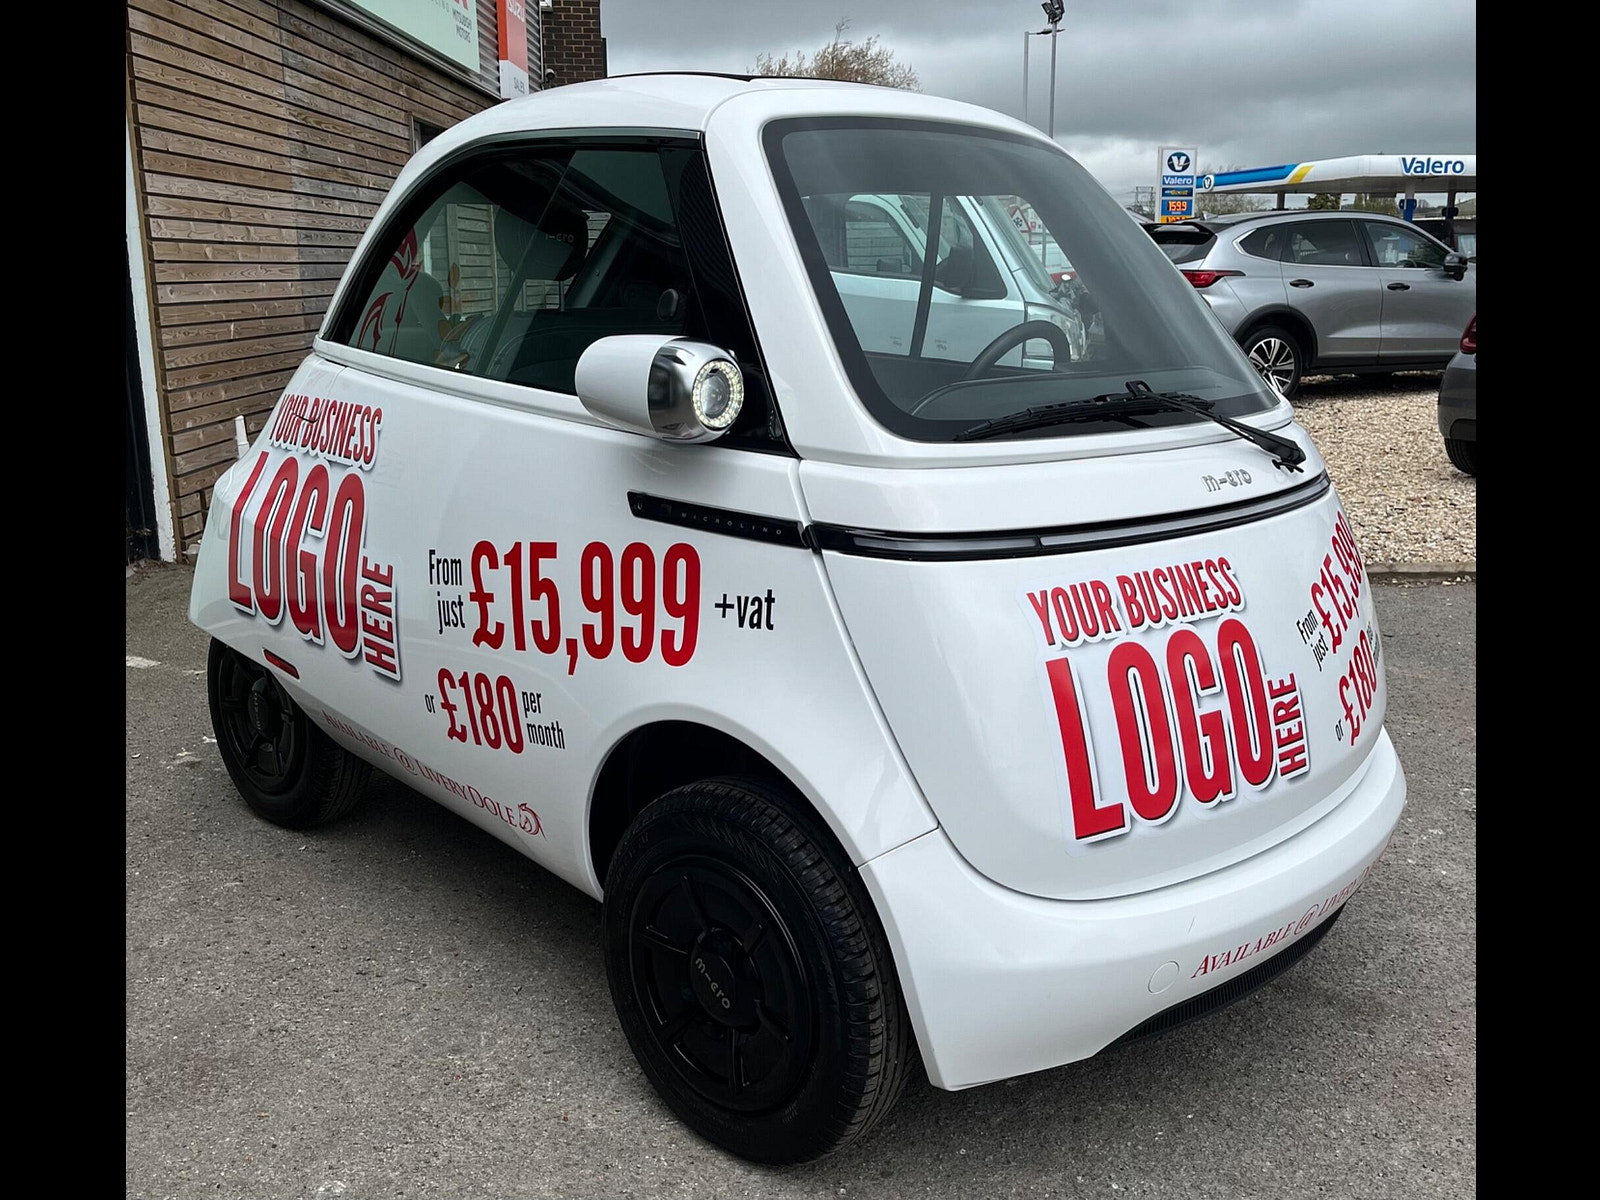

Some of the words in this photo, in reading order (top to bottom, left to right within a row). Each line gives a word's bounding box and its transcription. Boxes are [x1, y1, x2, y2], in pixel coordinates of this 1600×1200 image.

[1162, 176, 1193, 186] Valero
[1401, 156, 1465, 174] Valero
[269, 393, 310, 449] YOUR
[301, 397, 383, 464] BUSINESS
[228, 451, 365, 654] LOGO
[680, 511, 783, 536] MICROLINO
[429, 549, 462, 586] From
[361, 555, 398, 675] HERE
[436, 590, 466, 635] just
[469, 539, 702, 676] £15,999
[714, 588, 776, 631] +vat
[1026, 579, 1122, 647] YOUR
[1115, 556, 1243, 628] BUSINESS
[1296, 608, 1319, 646] From
[1309, 630, 1329, 673] just
[424, 693, 435, 714] or
[437, 667, 525, 755] £180
[521, 690, 542, 718] per
[1339, 629, 1377, 747] £180
[321, 709, 394, 760] AVAILABLE
[393, 746, 418, 776] @
[526, 720, 565, 750] month
[1045, 617, 1275, 841] LOGO
[1266, 672, 1307, 778] HERE
[1335, 718, 1344, 742] or
[1190, 920, 1296, 980] AVAILABLE
[1293, 902, 1320, 936] @
